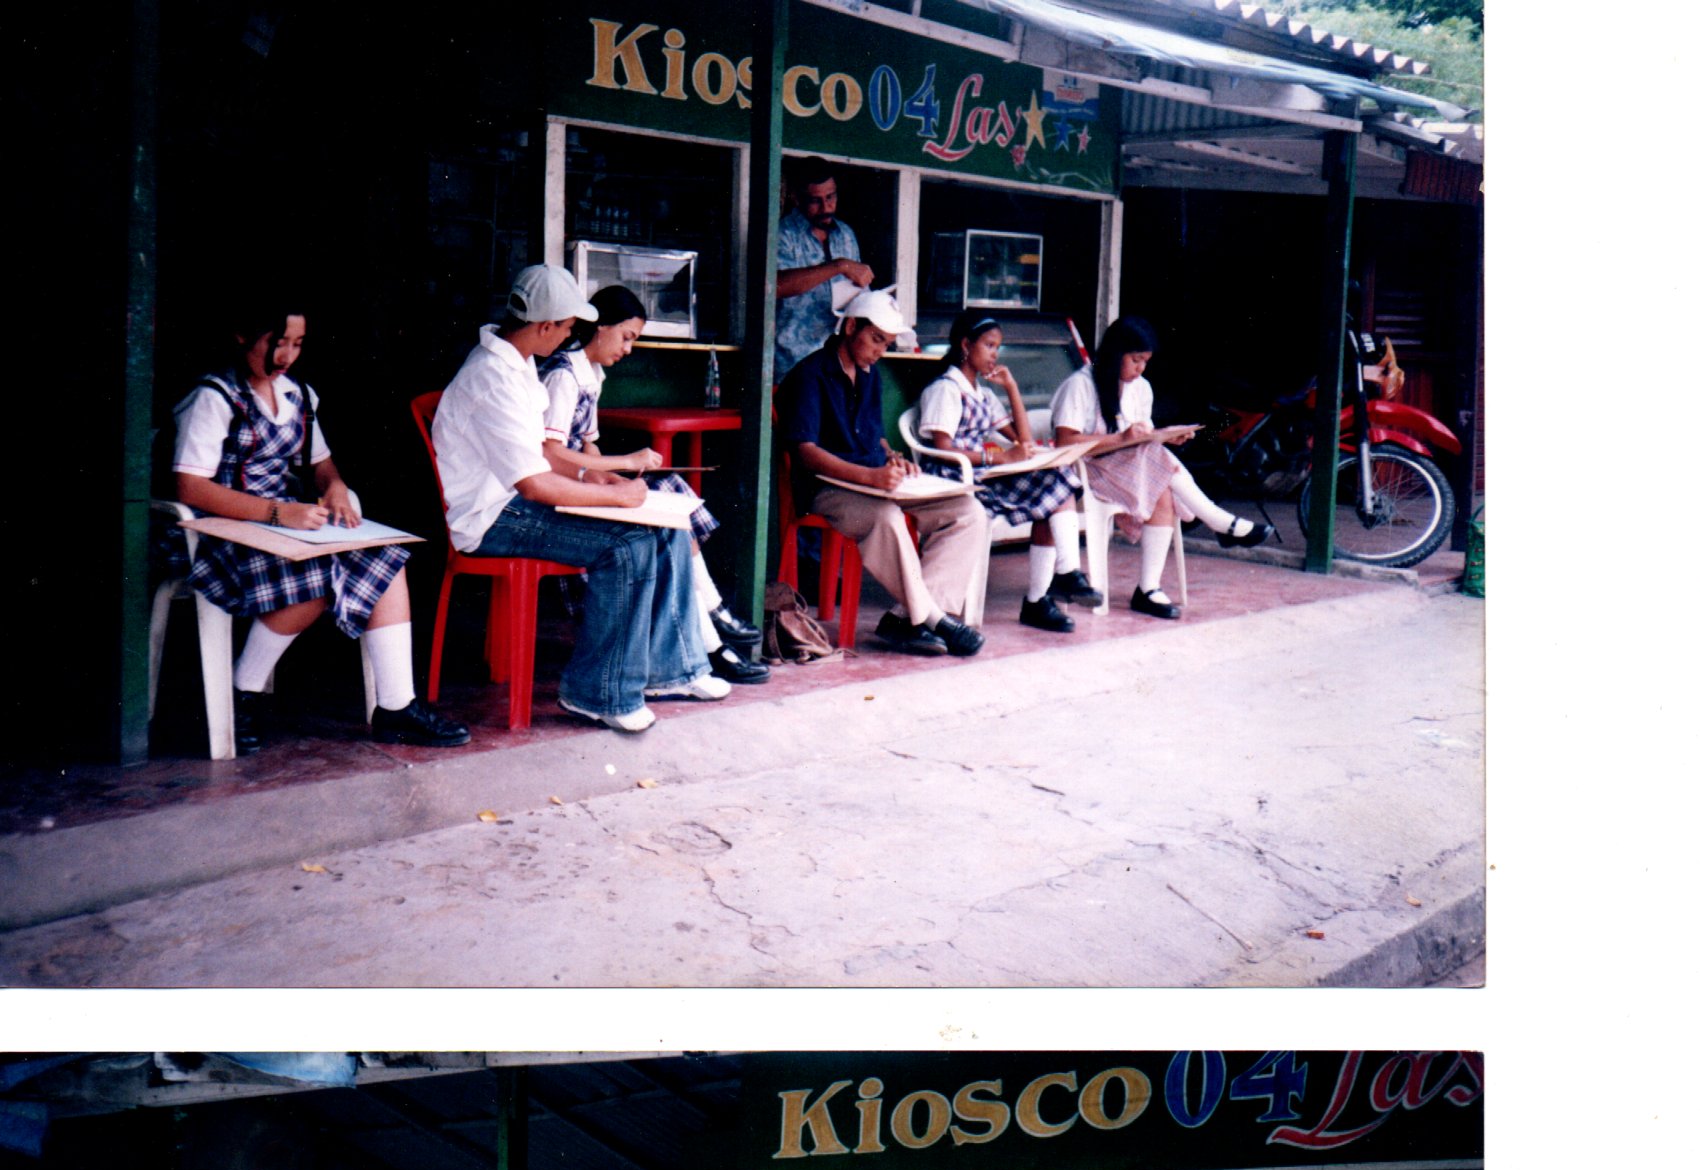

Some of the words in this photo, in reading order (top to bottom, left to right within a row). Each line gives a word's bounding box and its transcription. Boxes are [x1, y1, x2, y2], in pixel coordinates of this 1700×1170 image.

[868, 63, 940, 138] 04
[922, 73, 1020, 161] Las
[772, 1066, 1152, 1159] Kiosco
[1164, 1050, 1308, 1128] 04
[1265, 1050, 1484, 1150] Las
